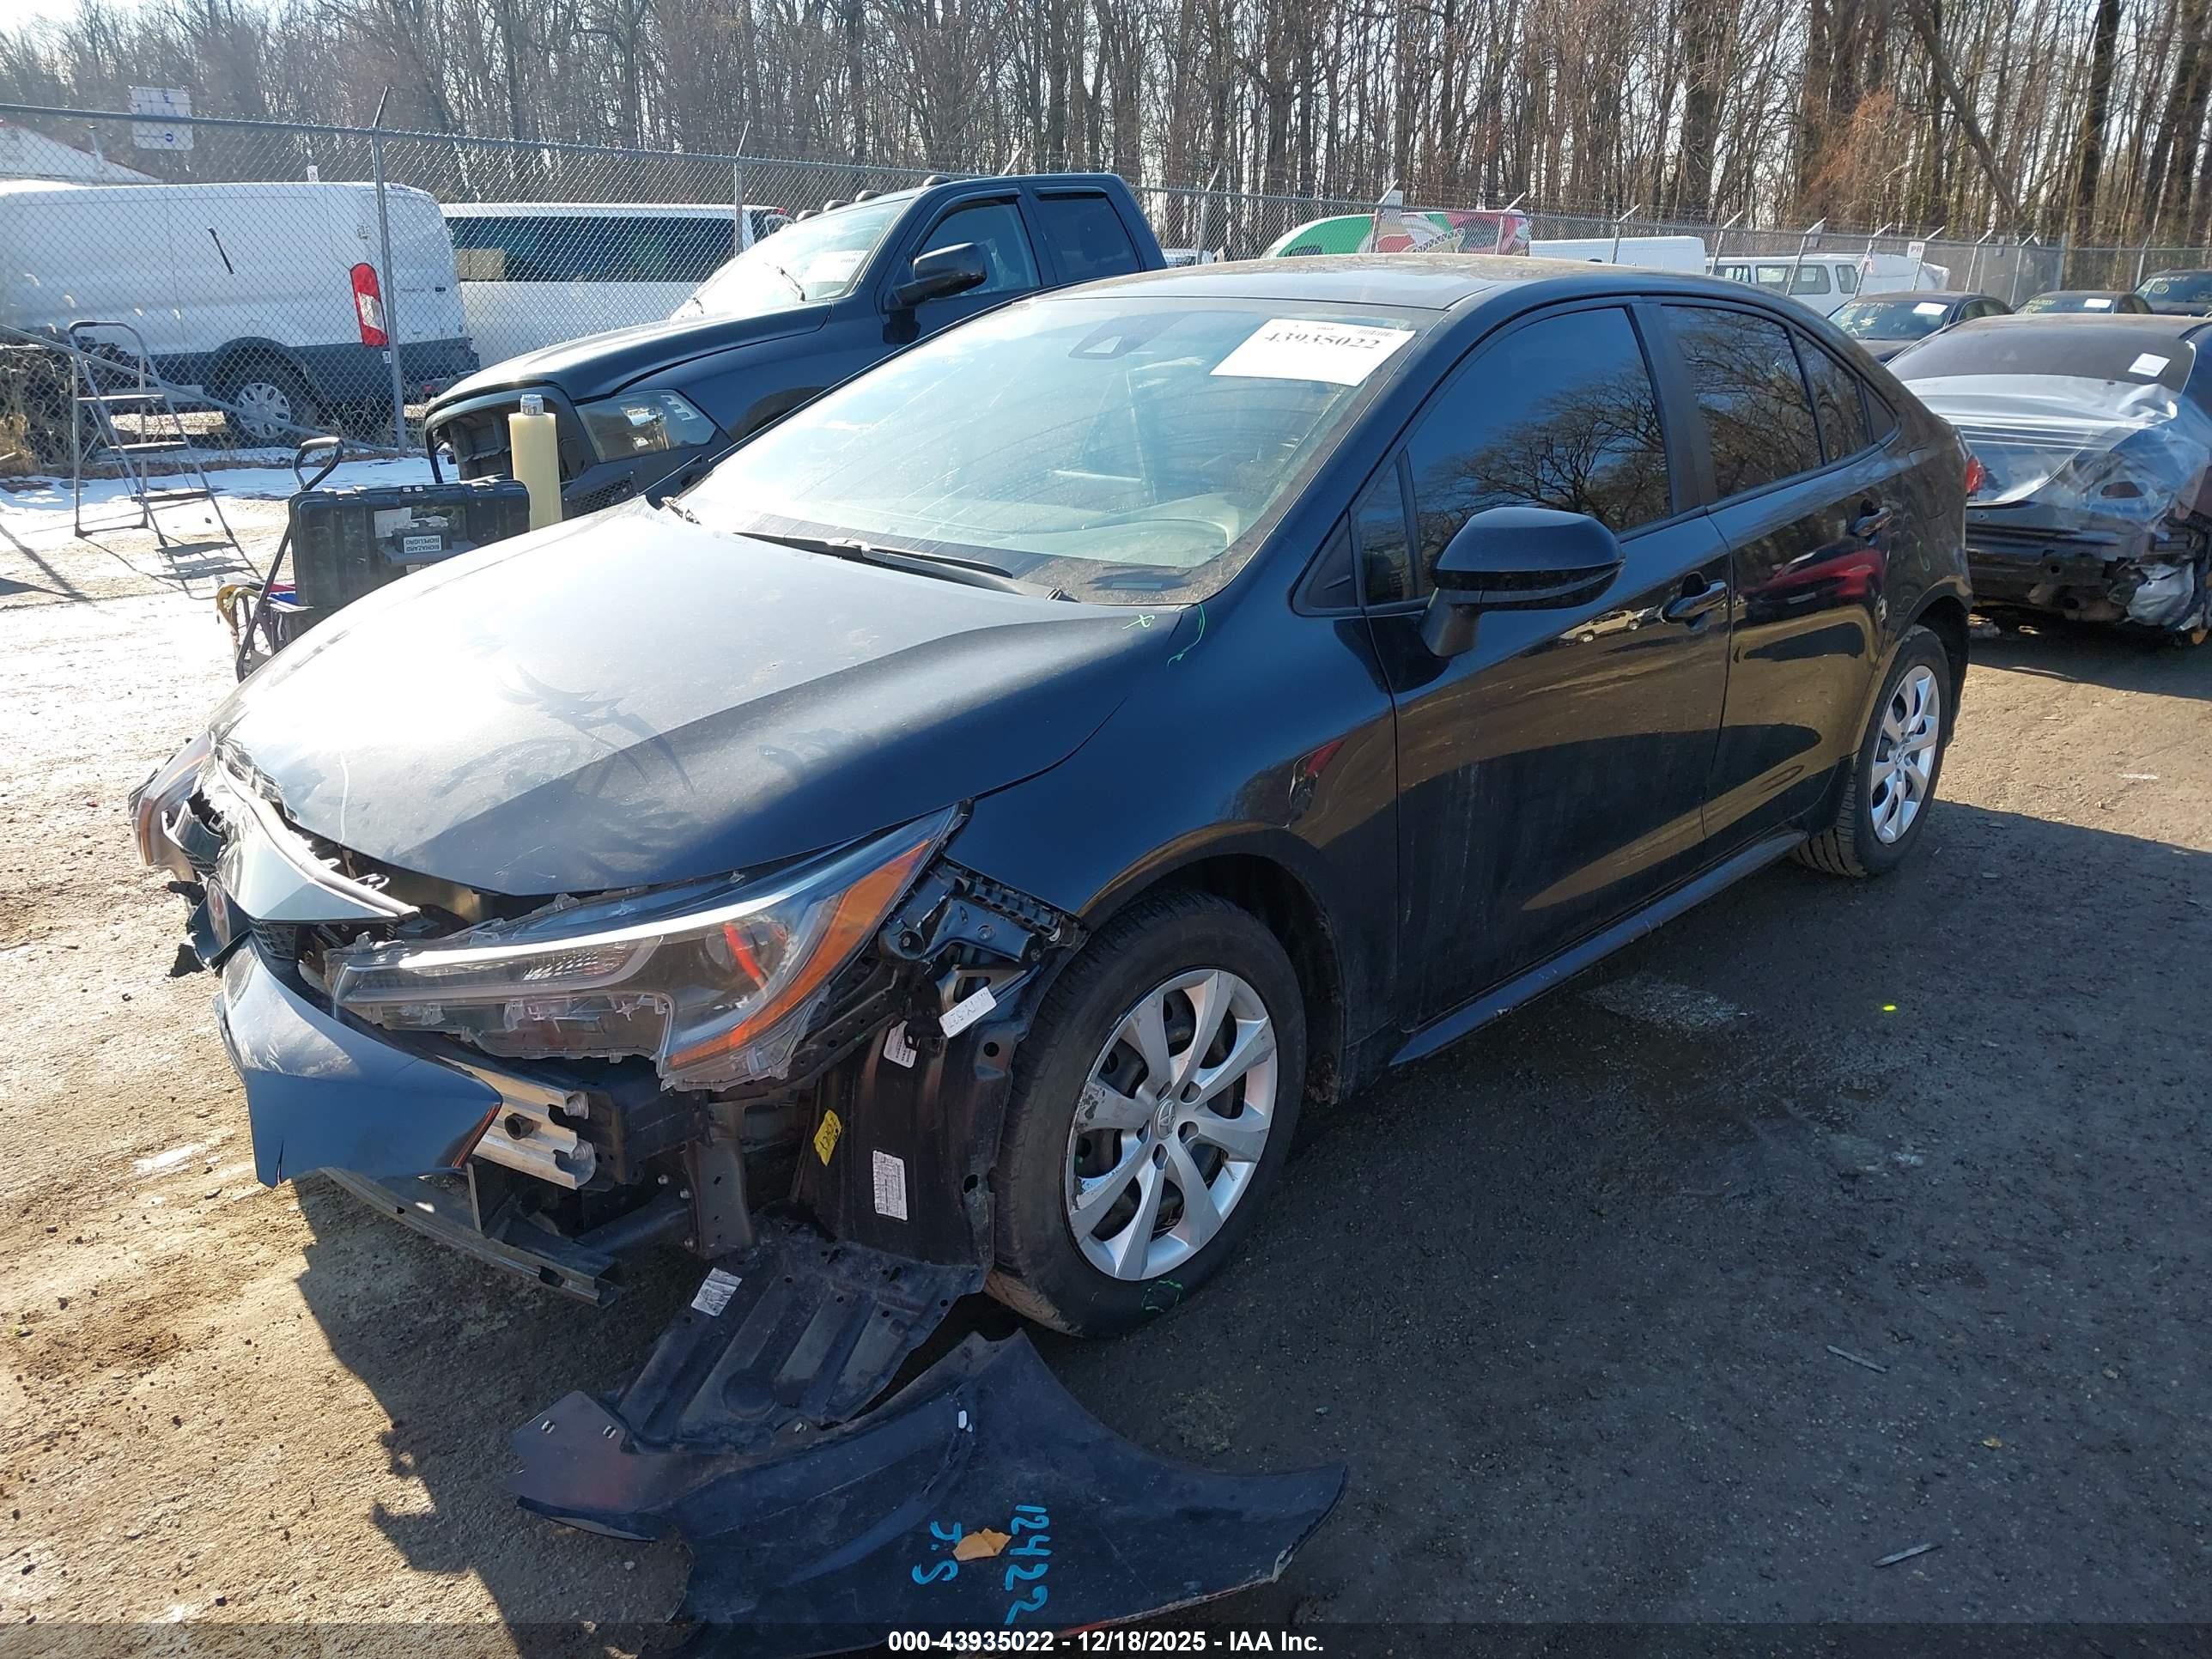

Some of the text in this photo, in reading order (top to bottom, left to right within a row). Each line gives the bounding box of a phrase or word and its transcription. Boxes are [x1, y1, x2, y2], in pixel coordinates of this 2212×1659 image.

[1265, 332, 1381, 349] 43935022
[405, 537, 440, 545] BIOPELIGRO
[1004, 1504, 1053, 1626] 12422
